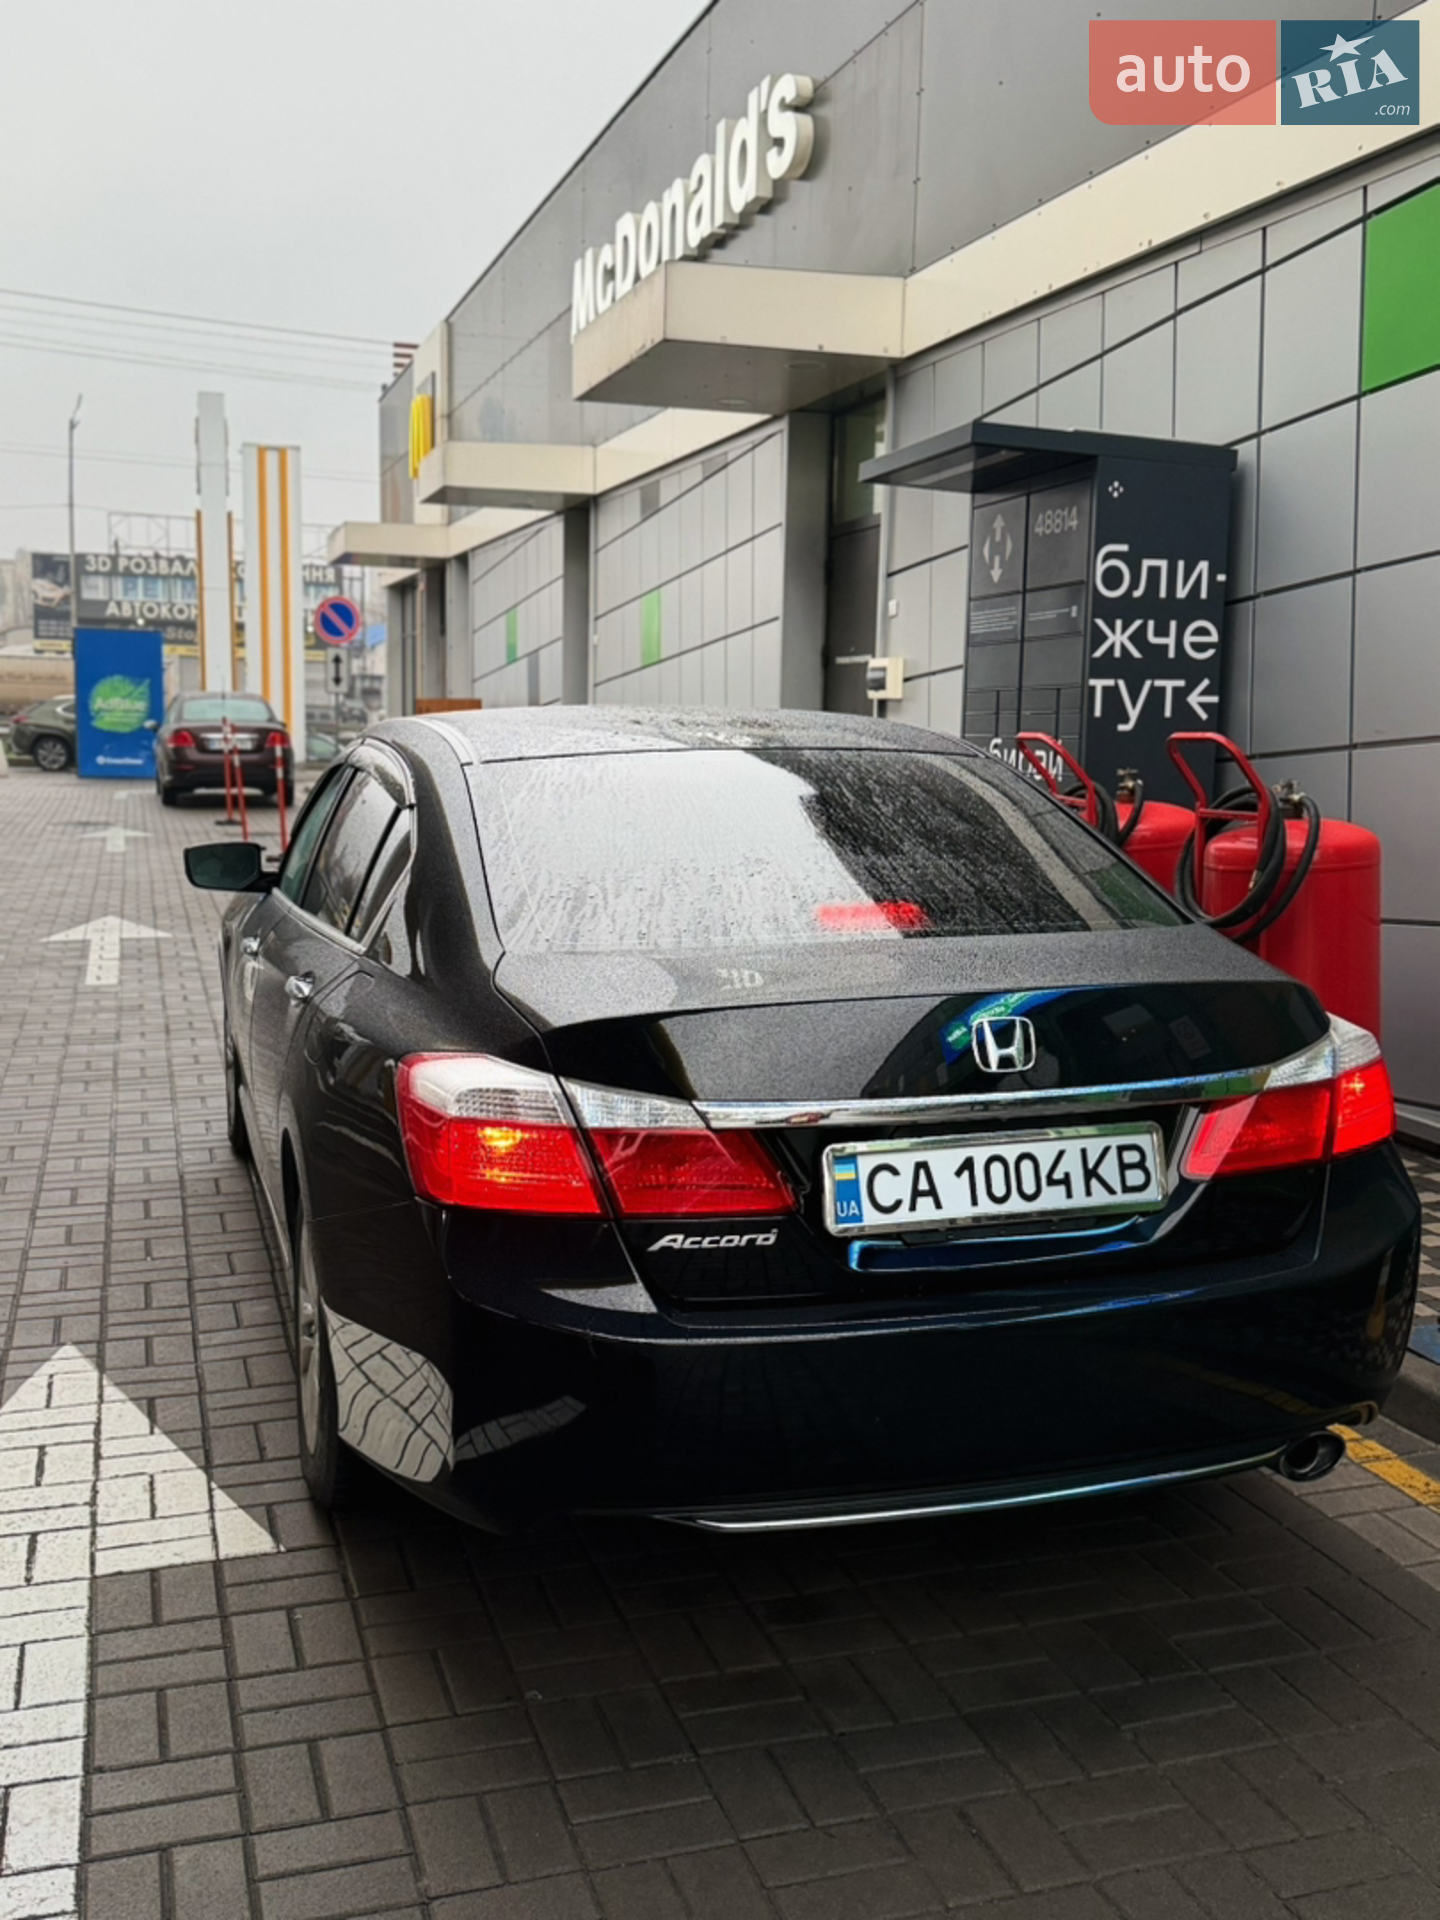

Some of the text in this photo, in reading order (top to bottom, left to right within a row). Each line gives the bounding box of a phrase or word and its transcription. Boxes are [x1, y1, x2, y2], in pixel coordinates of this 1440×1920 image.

[571, 73, 811, 343] McDonald's
[1034, 506, 1079, 537] 48814
[1091, 618, 1219, 660] жче
[1087, 678, 1186, 732] тут
[866, 1143, 1152, 1215] CA 1004 KB
[836, 1200, 862, 1218] UA
[647, 1227, 779, 1252] Accord
